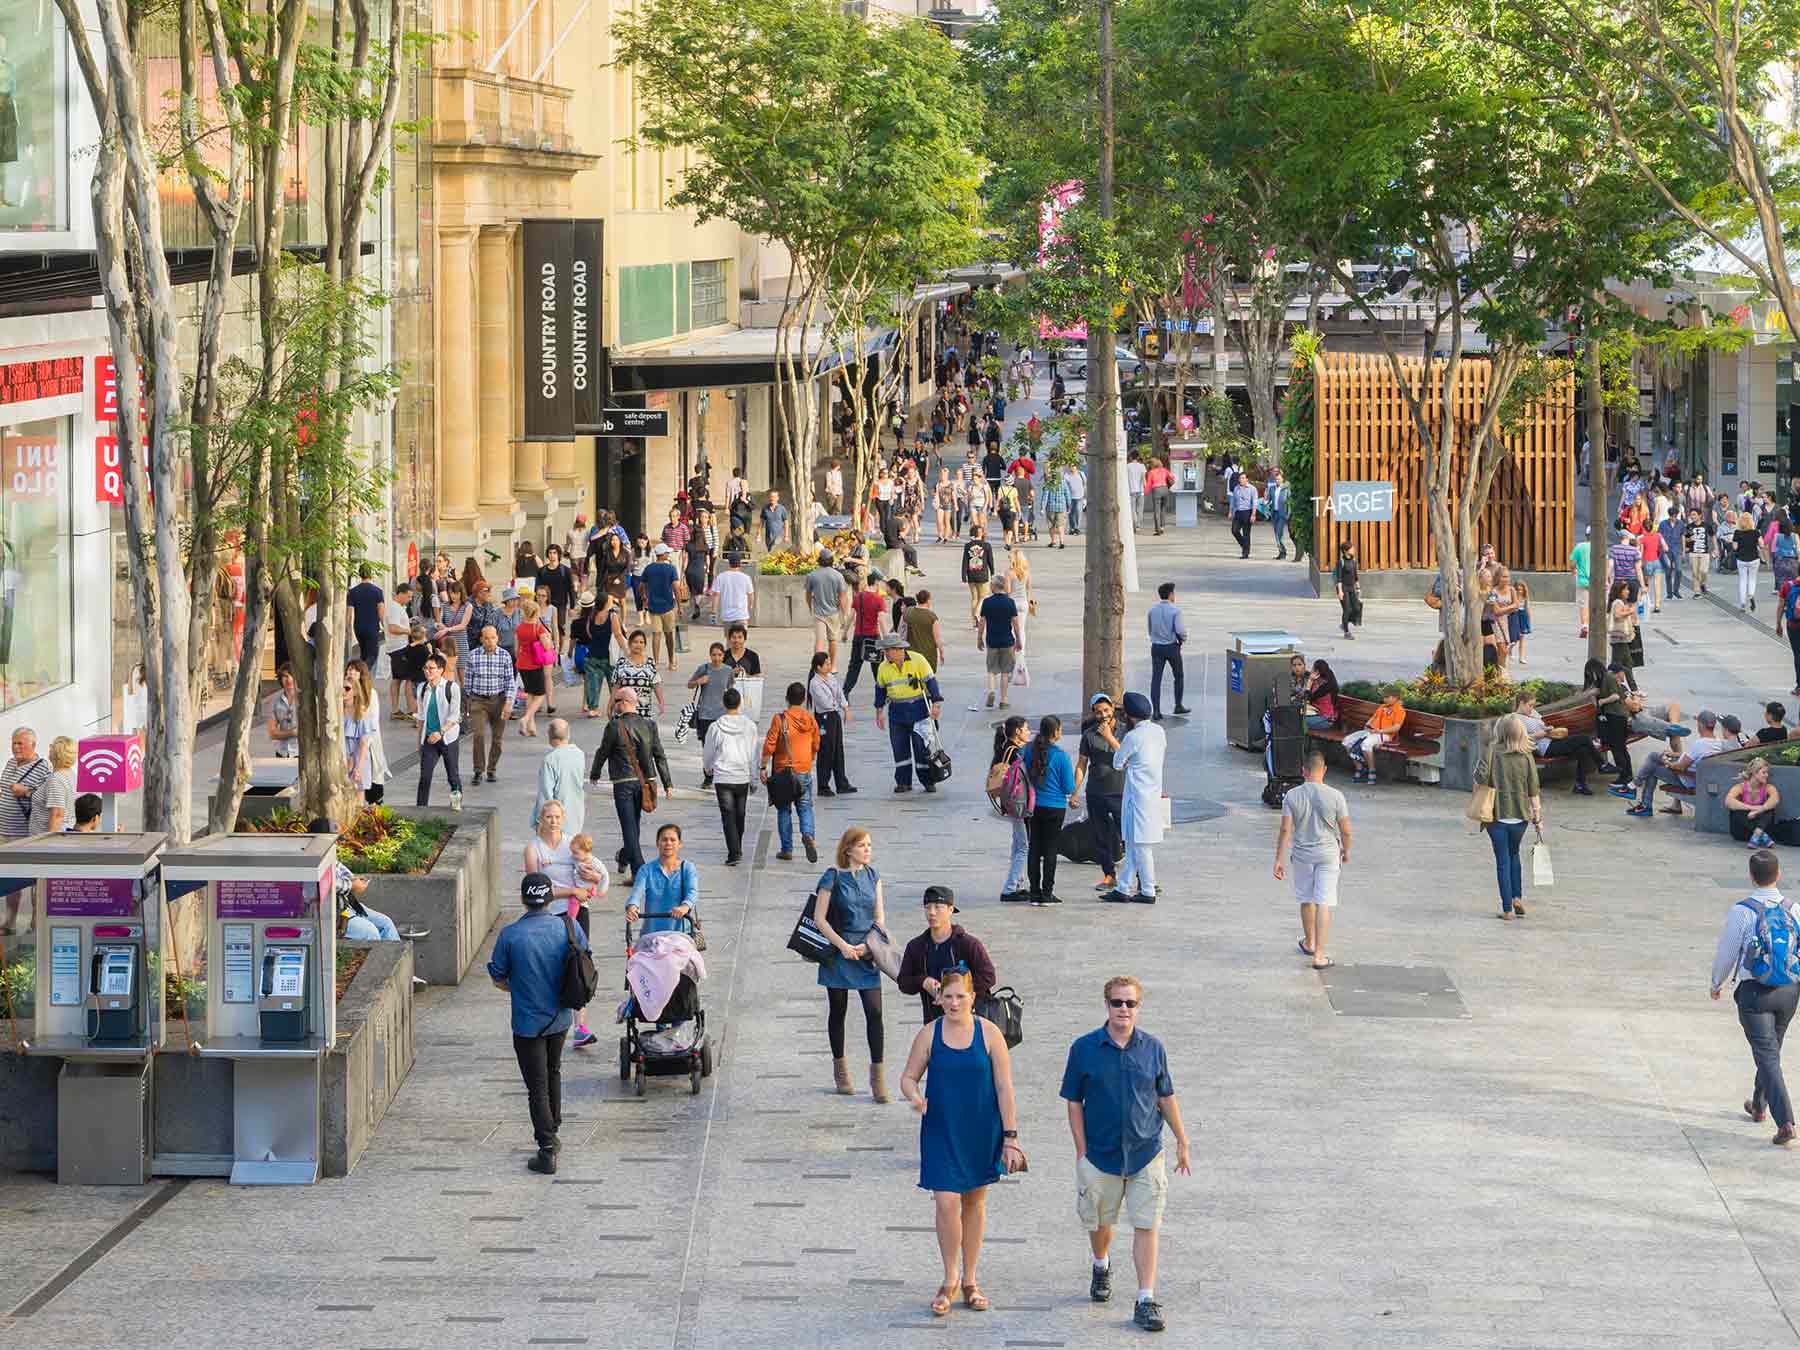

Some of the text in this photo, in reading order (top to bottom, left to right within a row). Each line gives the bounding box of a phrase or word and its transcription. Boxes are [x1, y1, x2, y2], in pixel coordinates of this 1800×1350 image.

[542, 262, 556, 399] COUNTRY ROAD
[573, 260, 587, 390] COUNTRY ROAD
[624, 412, 638, 420] safe
[1310, 487, 1398, 518] TARGET
